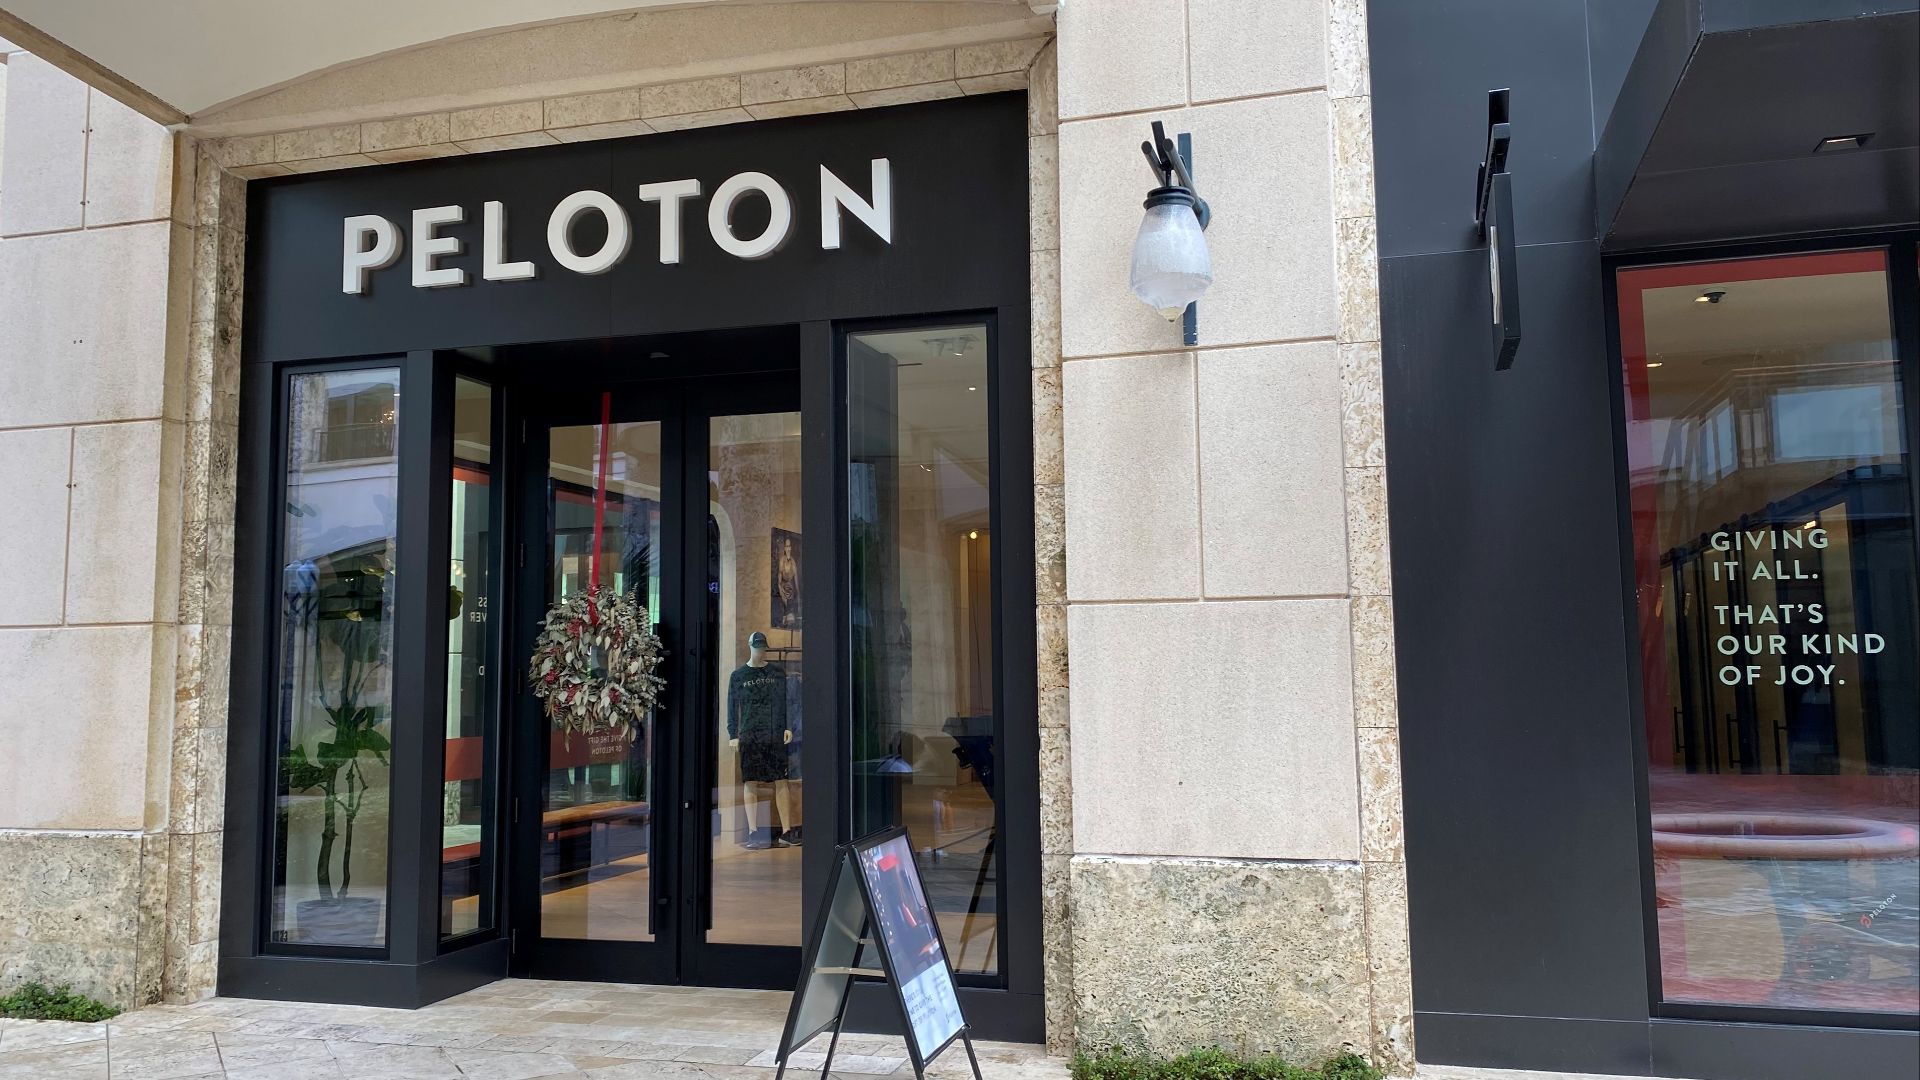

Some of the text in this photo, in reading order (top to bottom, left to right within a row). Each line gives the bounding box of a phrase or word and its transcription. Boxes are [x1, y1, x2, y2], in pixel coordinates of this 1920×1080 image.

[343, 158, 892, 295] PELOTON
[1710, 528, 1829, 551] GIVING
[1713, 559, 1819, 581] IT ALL.
[1713, 603, 1824, 625] THAT'S
[1716, 633, 1886, 656] OUR KIND
[1718, 664, 1846, 686] OF JOY.
[1869, 893, 1897, 920] PELOTON
